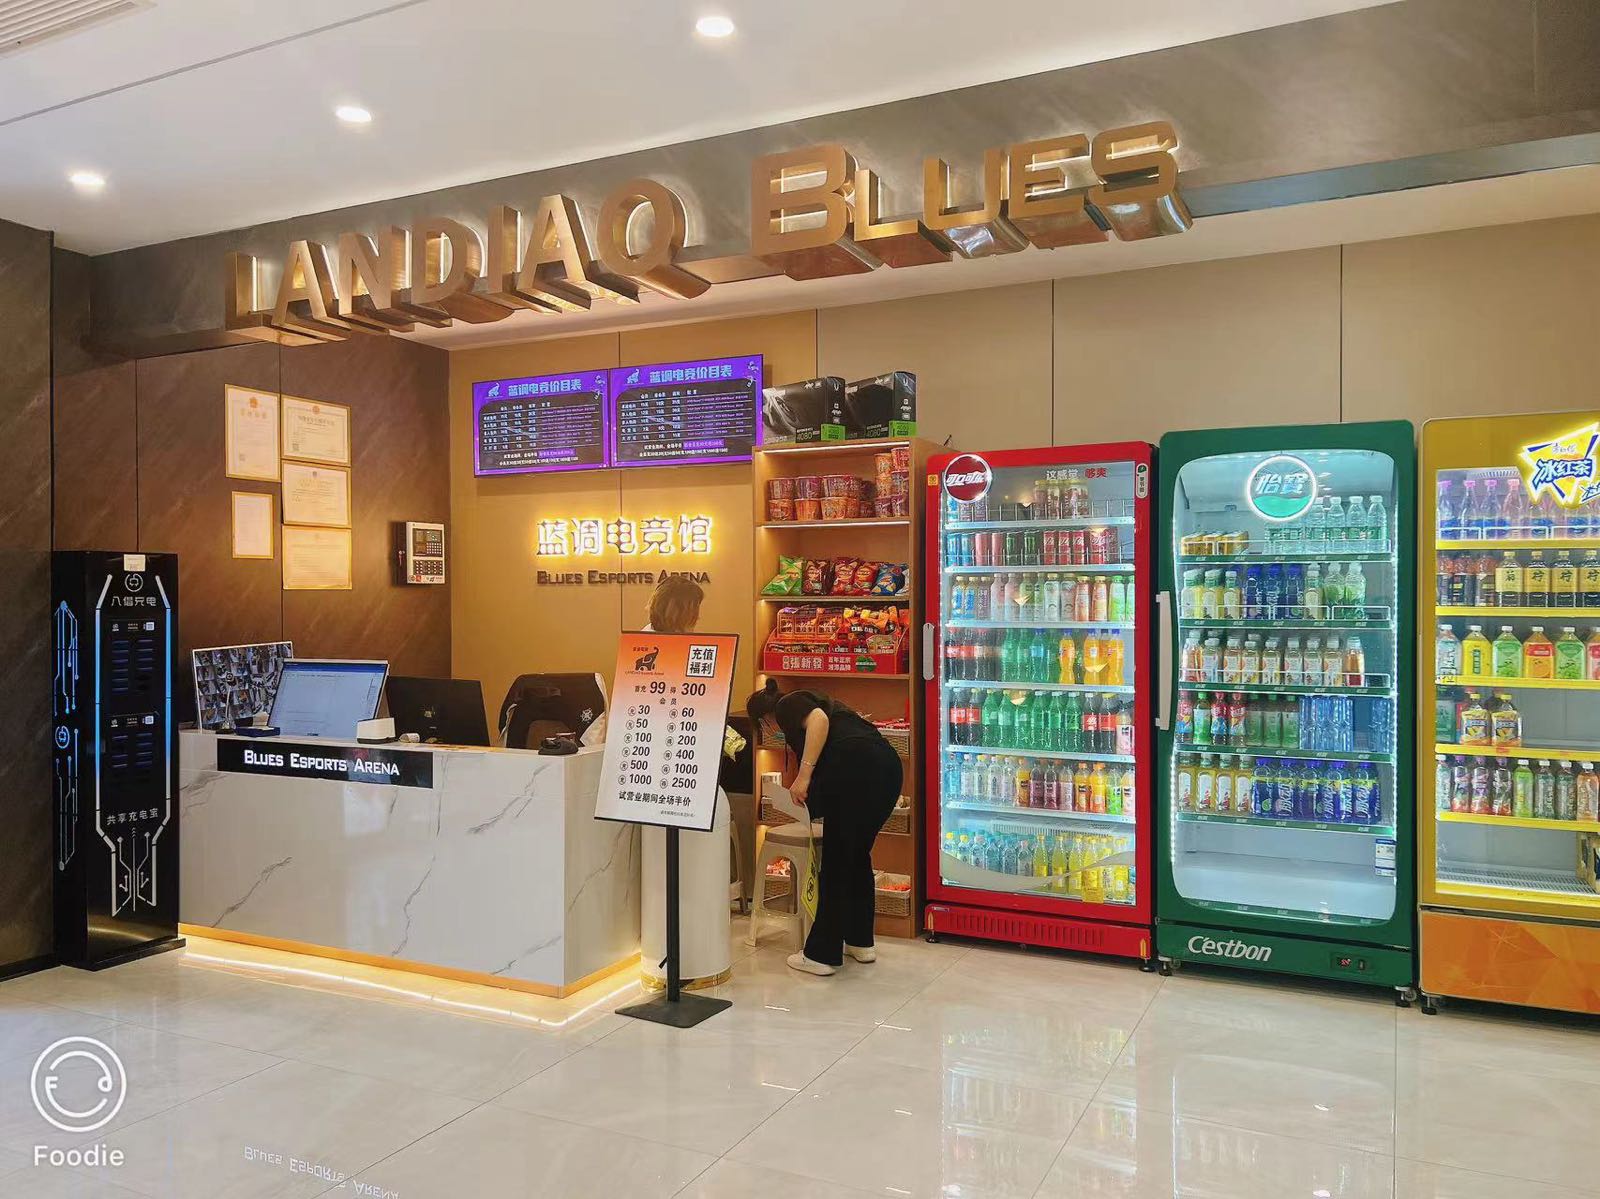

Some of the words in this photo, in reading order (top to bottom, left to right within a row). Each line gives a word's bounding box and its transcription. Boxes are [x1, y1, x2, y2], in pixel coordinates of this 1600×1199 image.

[751, 121, 1181, 254] BLUES
[650, 365, 732, 383] 蓝调电竞价目表
[1534, 459, 1592, 488] 冰红茶
[537, 516, 710, 556] 蓝调电竞馆
[691, 648, 714, 661] 充值
[690, 662, 713, 675] 福利
[650, 681, 666, 694] 99
[681, 682, 706, 696] 300
[638, 705, 650, 715] 30
[682, 708, 694, 717] 60
[636, 719, 648, 728] 50
[680, 722, 697, 732] 100
[635, 733, 652, 742] 100
[678, 735, 696, 746] 200
[632, 746, 650, 756] 200
[676, 750, 694, 760] 400
[630, 760, 648, 770] 500
[675, 764, 698, 774] 1000
[629, 774, 652, 784] 1000
[672, 778, 696, 789] 2500
[618, 790, 691, 807] 试营业期间全场半价
[106, 808, 159, 826] 共享充电宝
